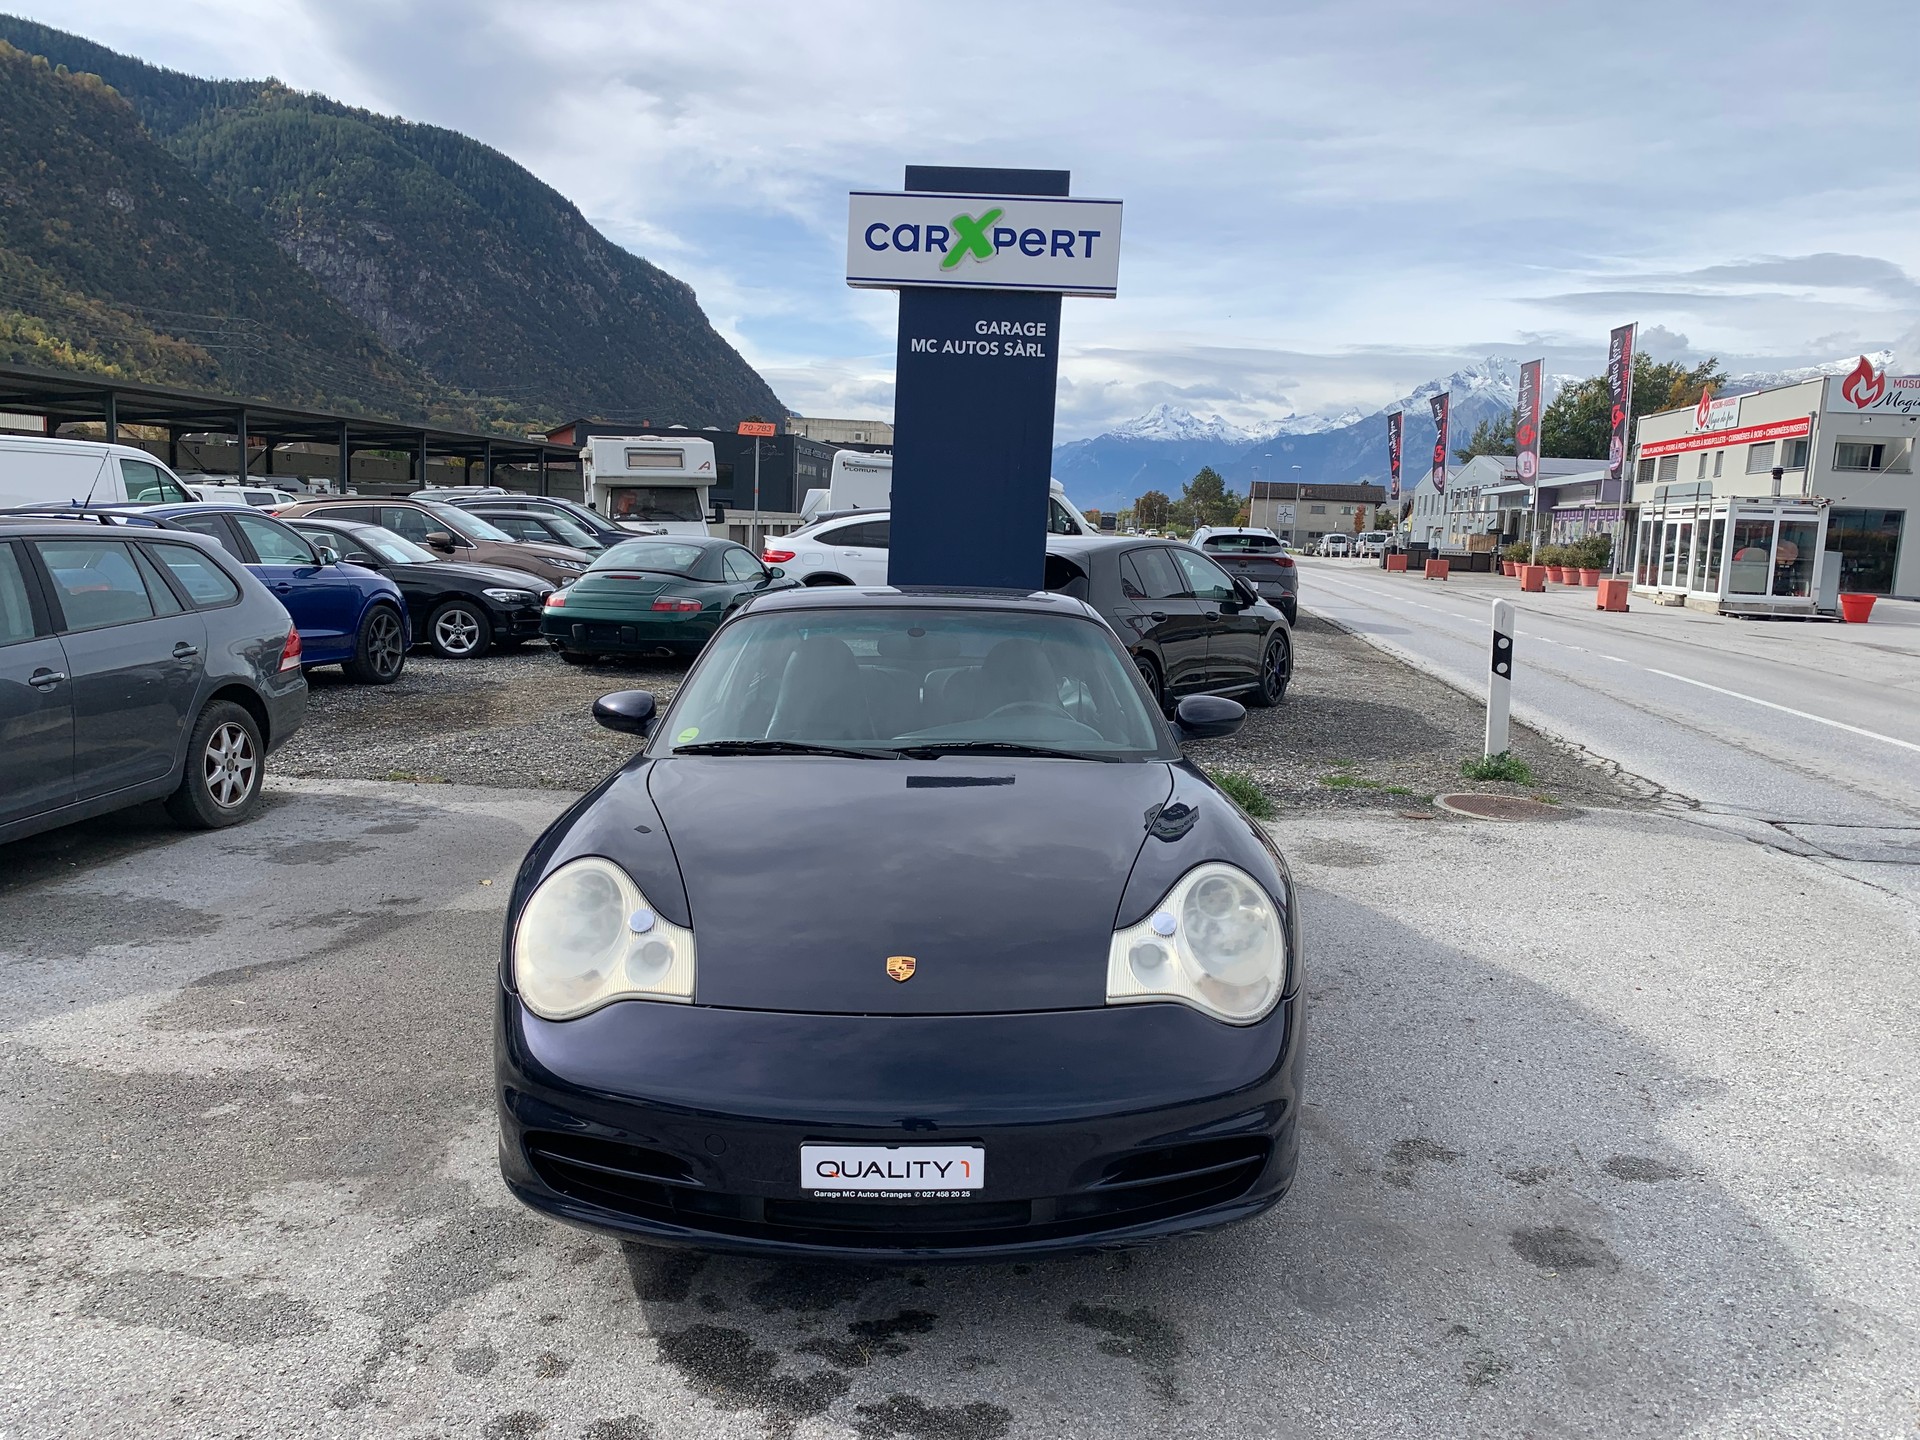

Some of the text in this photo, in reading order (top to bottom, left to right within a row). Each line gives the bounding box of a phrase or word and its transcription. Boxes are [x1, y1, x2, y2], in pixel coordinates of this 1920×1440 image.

[975, 320, 1047, 337] GARAGE
[911, 338, 1046, 358] MC AUTOS SÀRL
[816, 1160, 970, 1178] QUALITY 1
[813, 1190, 841, 1199] Garage
[880, 1191, 912, 1199] Granges
